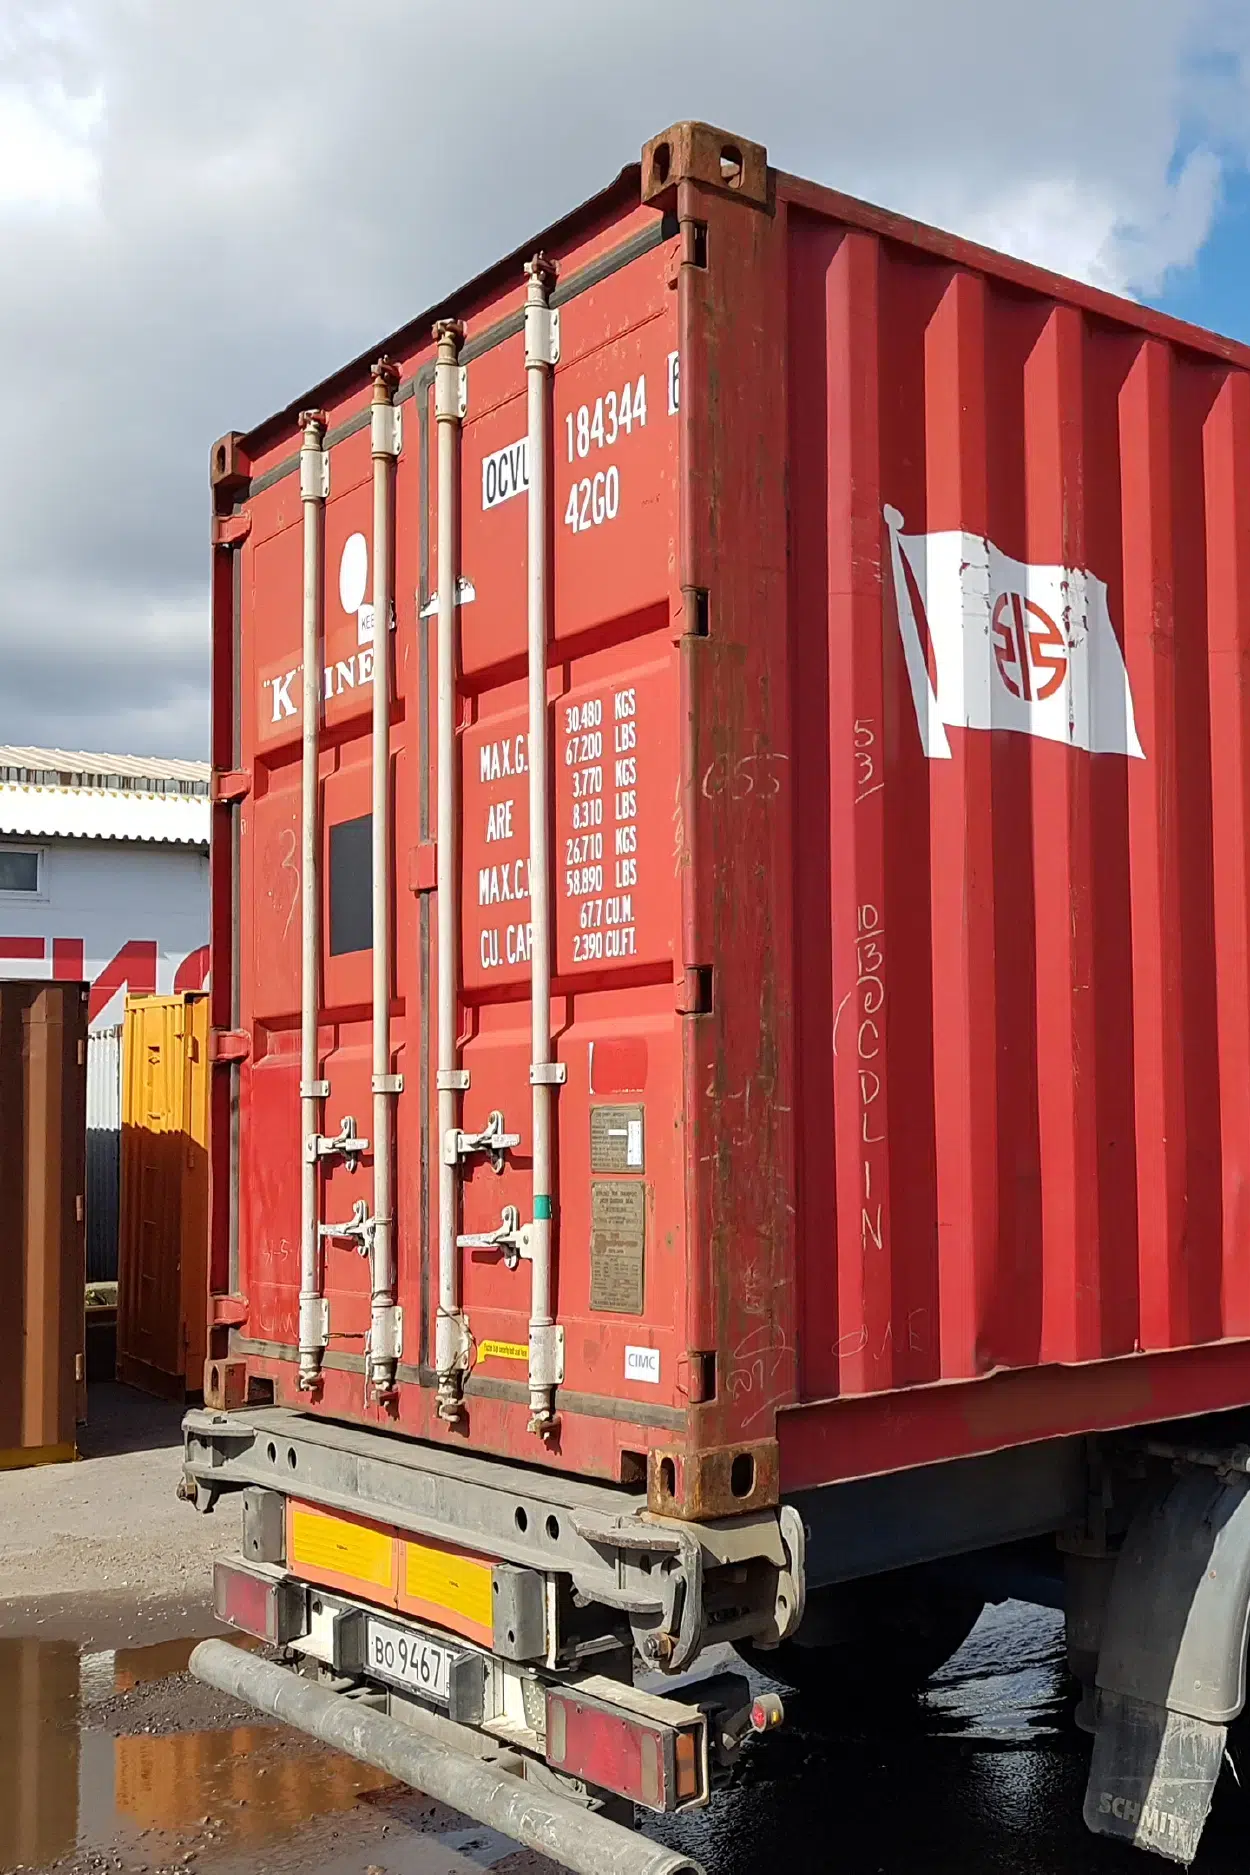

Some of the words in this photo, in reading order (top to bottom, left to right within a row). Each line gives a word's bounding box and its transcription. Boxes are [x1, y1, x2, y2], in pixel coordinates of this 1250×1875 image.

[565, 374, 647, 463] 184344
[318, 648, 374, 702] INE
[614, 688, 636, 720] KGS
[615, 721, 637, 753] LBS
[480, 733, 530, 783] MAX.G.
[615, 757, 637, 788] KGS
[615, 789, 637, 820] LBS
[615, 825, 637, 856] KGS
[479, 858, 532, 906] MAX.C.
[615, 858, 637, 888] LBS
[580, 898, 603, 929] 67.7
[480, 929, 503, 969] CU.
[628, 1353, 656, 1370] CIMC
[398, 1638, 441, 1688] 9467
